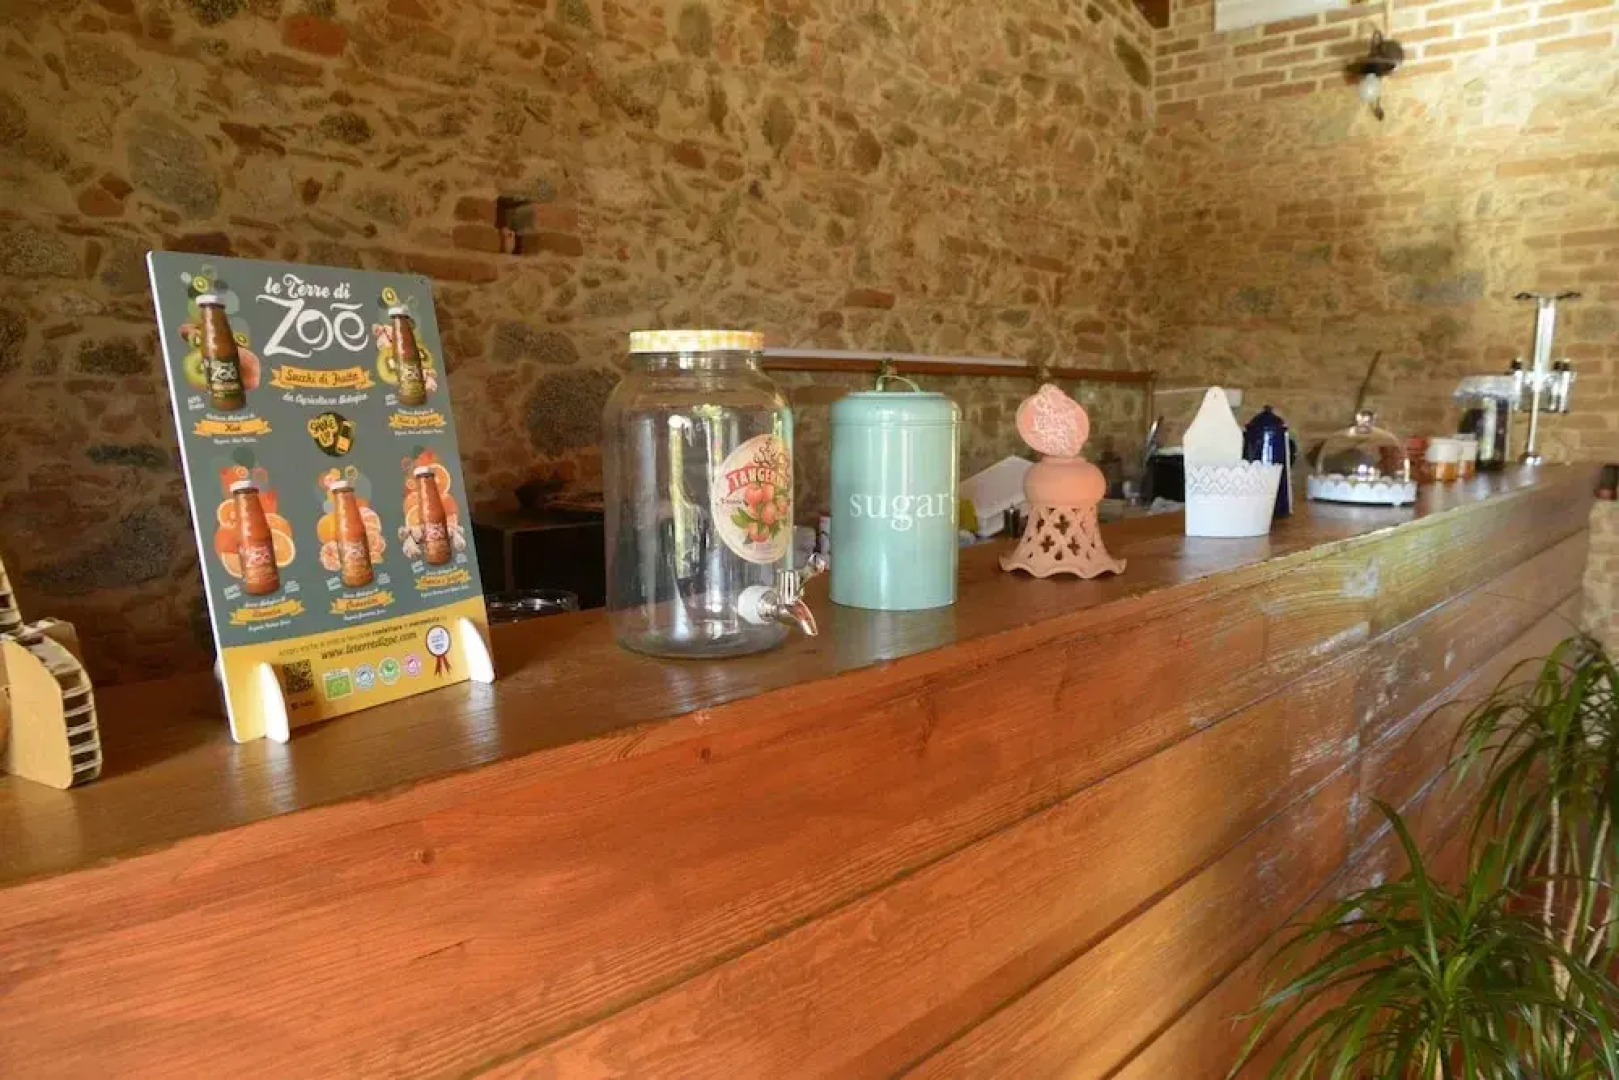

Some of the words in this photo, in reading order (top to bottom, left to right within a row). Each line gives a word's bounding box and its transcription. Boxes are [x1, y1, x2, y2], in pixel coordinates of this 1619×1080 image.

[264, 276, 281, 295] le
[283, 273, 330, 298] Terre
[333, 282, 351, 299] di
[849, 492, 949, 531] sugar
